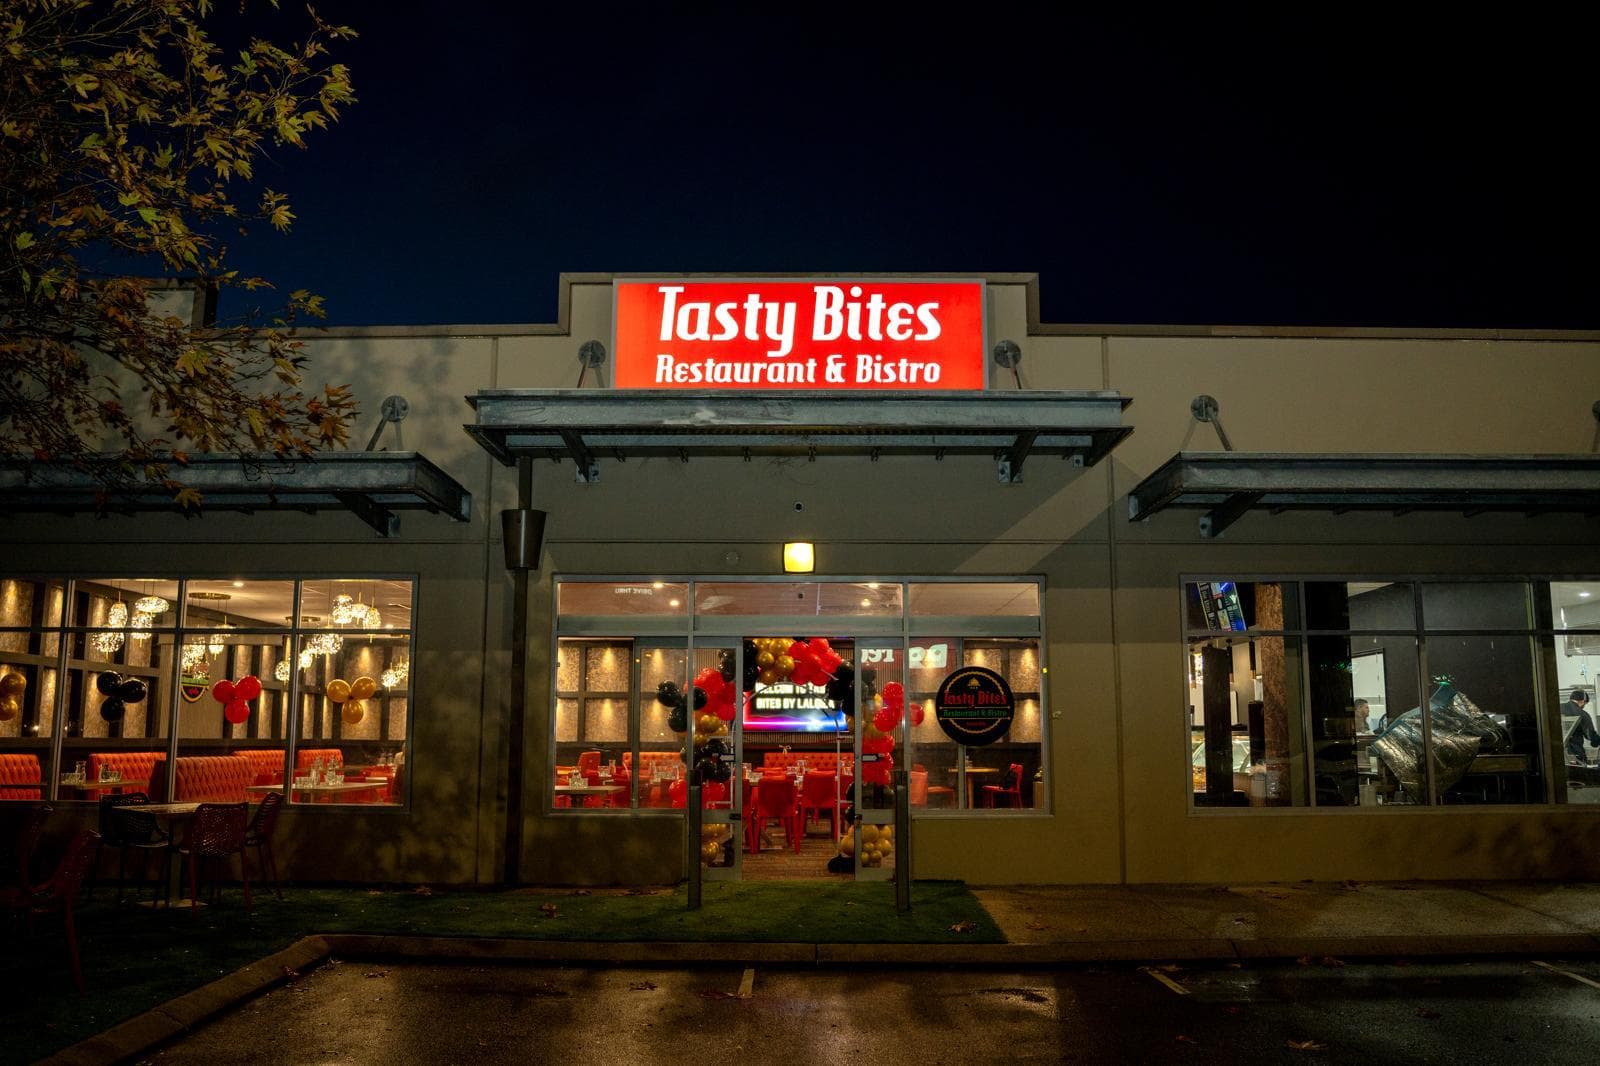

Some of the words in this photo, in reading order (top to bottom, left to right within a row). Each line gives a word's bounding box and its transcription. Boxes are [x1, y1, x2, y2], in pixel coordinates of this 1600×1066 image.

[657, 285, 797, 358] Tasty
[811, 285, 942, 341] Bites
[655, 354, 818, 383] Restaurant
[824, 354, 846, 383] &
[855, 354, 941, 383] Bistro
[756, 697, 781, 709] BITES
[782, 697, 796, 709] BY
[943, 689, 976, 707] Tasty
[977, 689, 1008, 705] Bites
